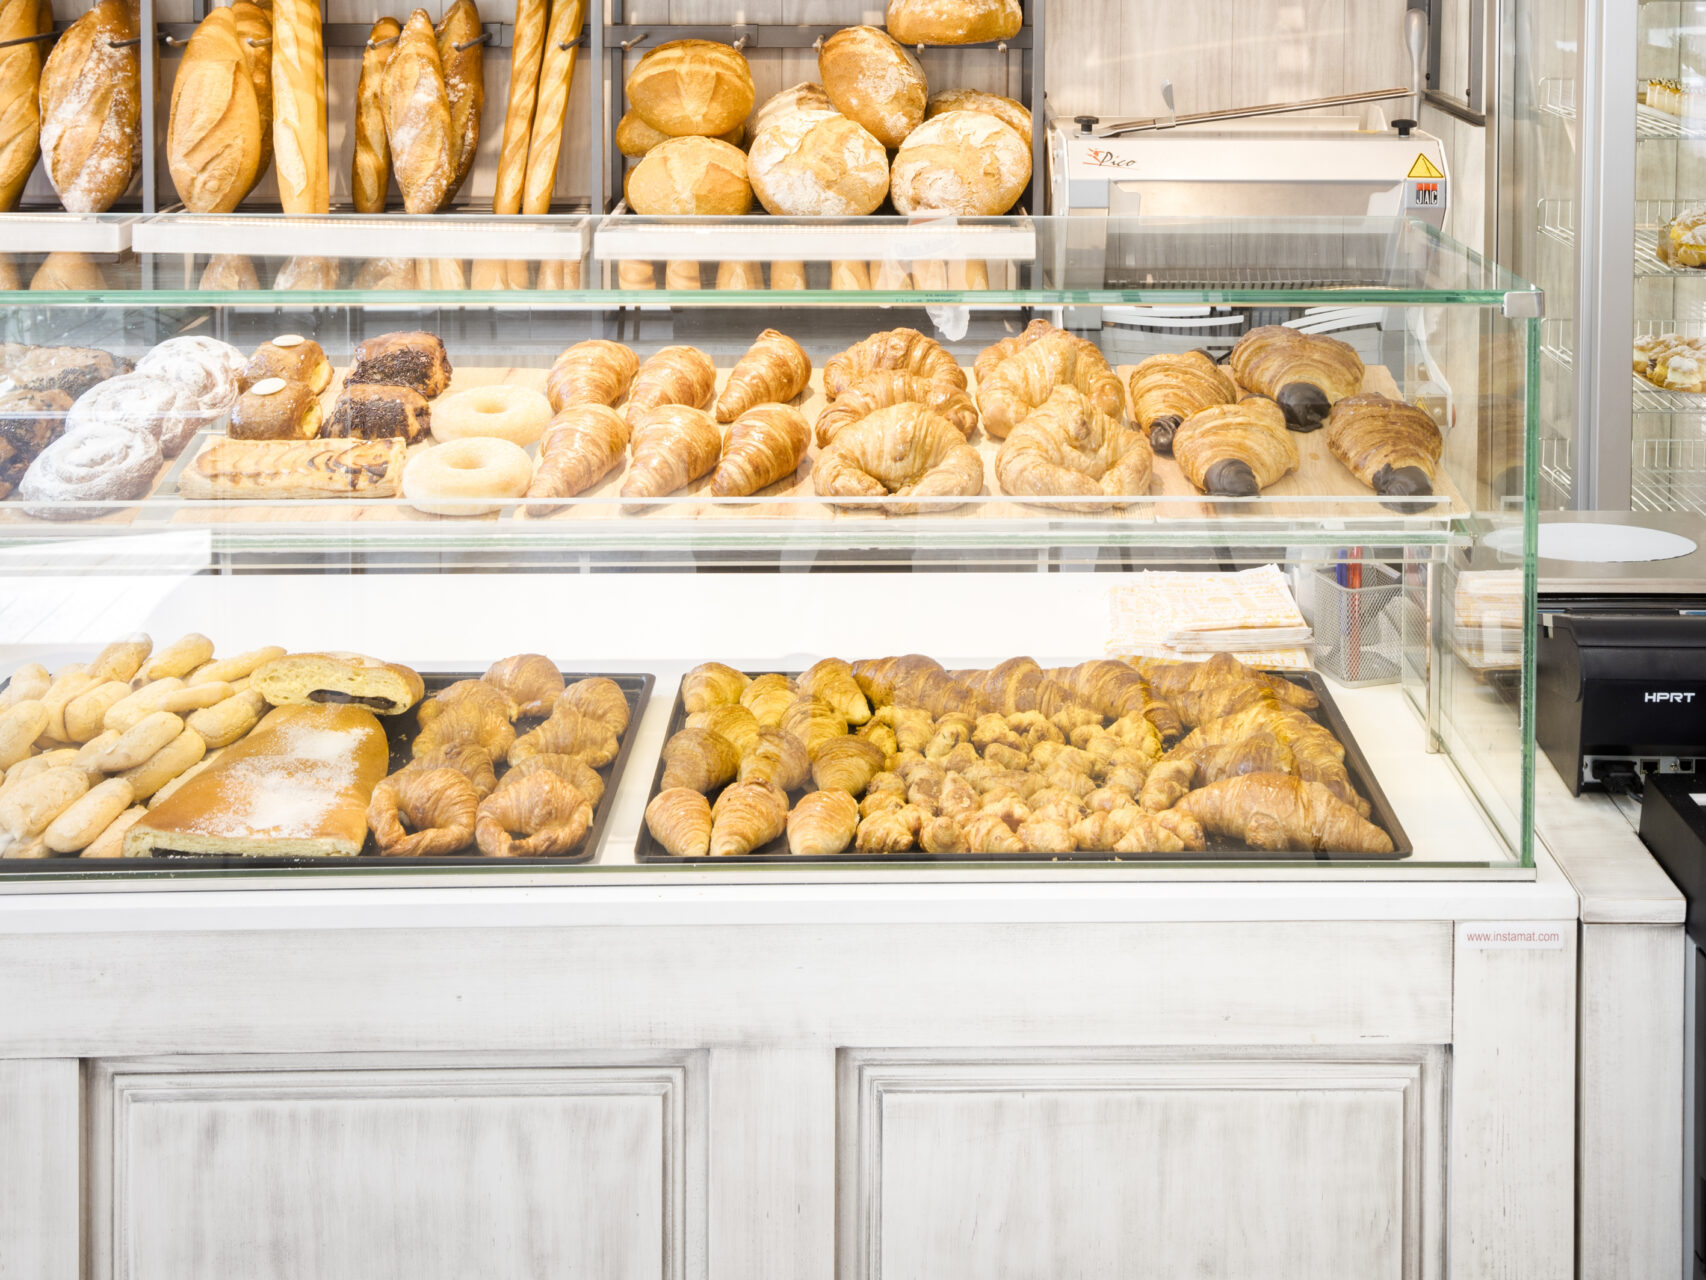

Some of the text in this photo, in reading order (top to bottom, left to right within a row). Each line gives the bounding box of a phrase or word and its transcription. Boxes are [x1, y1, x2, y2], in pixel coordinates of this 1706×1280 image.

[1099, 151, 1136, 167] Pico
[1416, 188, 1438, 205] JAC
[1645, 693, 1696, 703] HPRT
[1466, 932, 1560, 942] www.instamat.com
